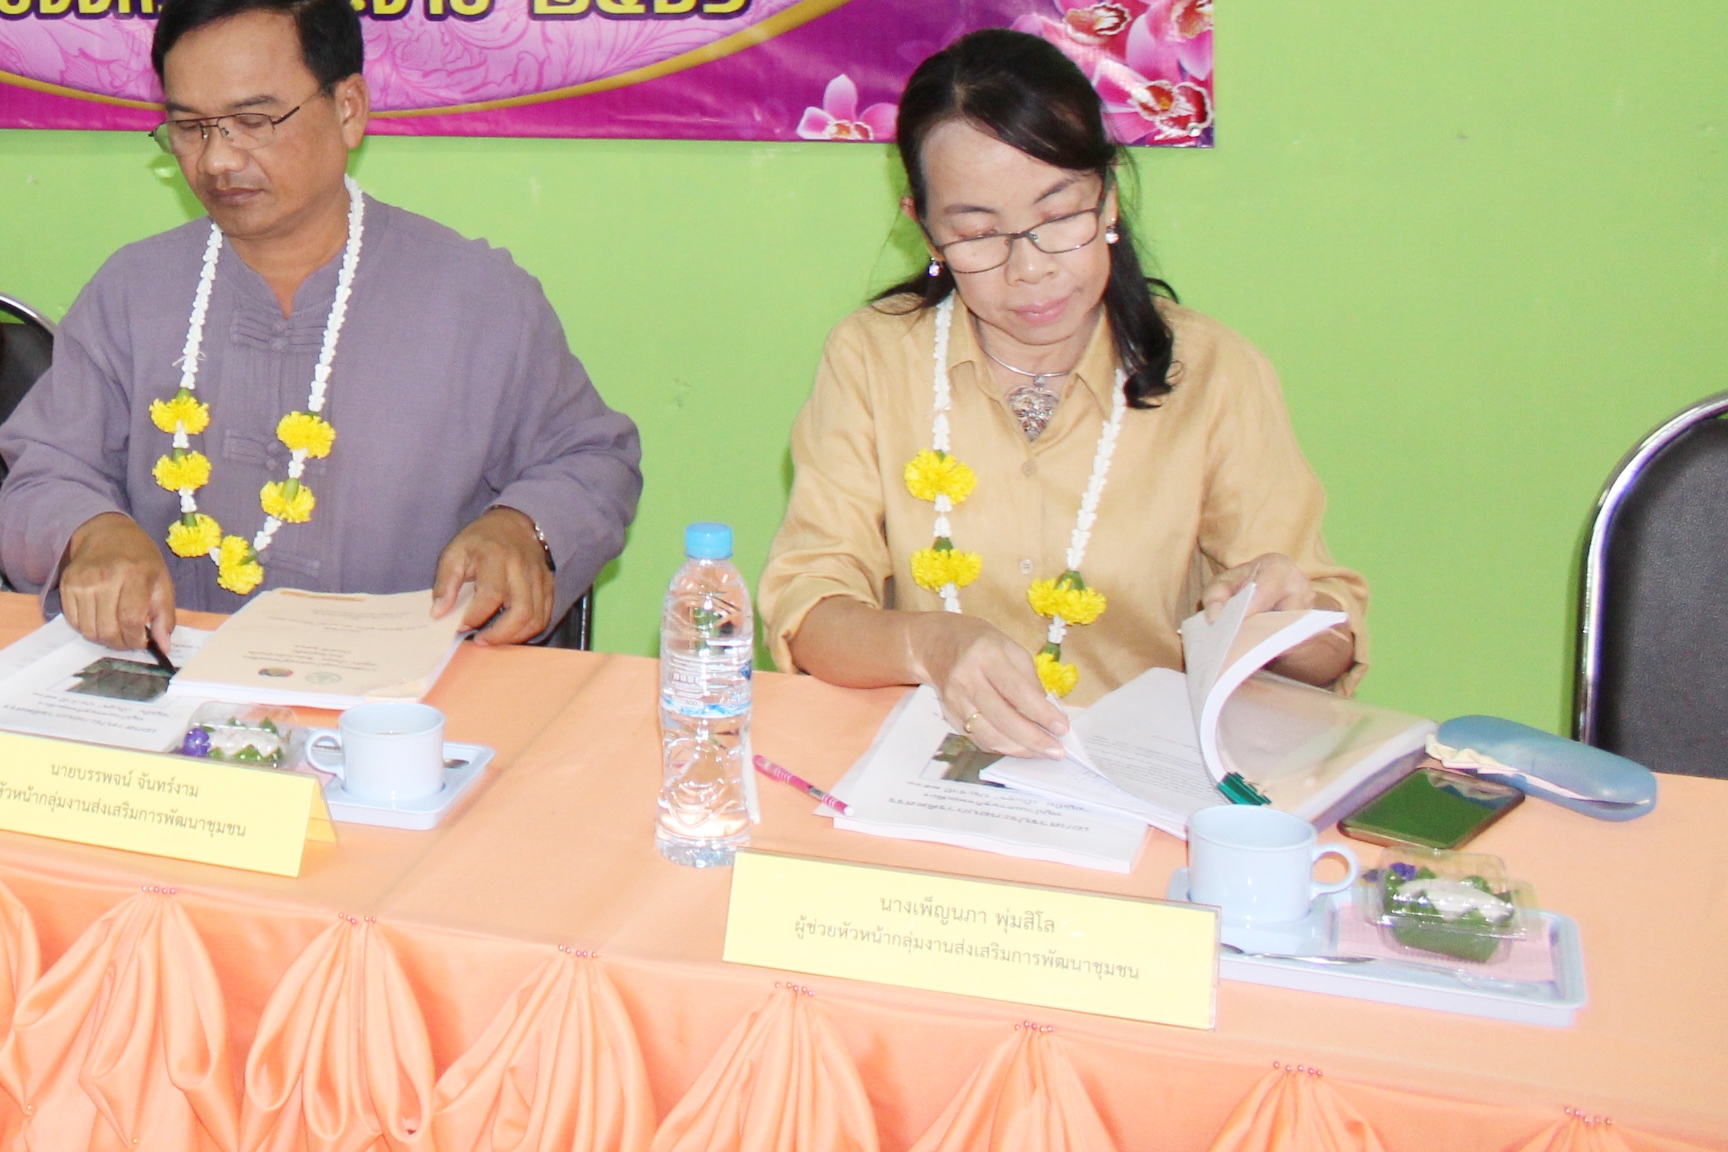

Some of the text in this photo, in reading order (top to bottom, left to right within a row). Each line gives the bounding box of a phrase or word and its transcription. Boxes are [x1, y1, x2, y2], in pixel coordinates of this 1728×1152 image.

[50, 762, 200, 798] นายบรรพจน์ จันทร์งาม
[880, 895, 988, 925] นางเพ็ญนภา
[795, 913, 1140, 981] ผู้ช่วยหัวหน้ากลุ่มงานส่งเสริมการพัฒนาชุมชน
